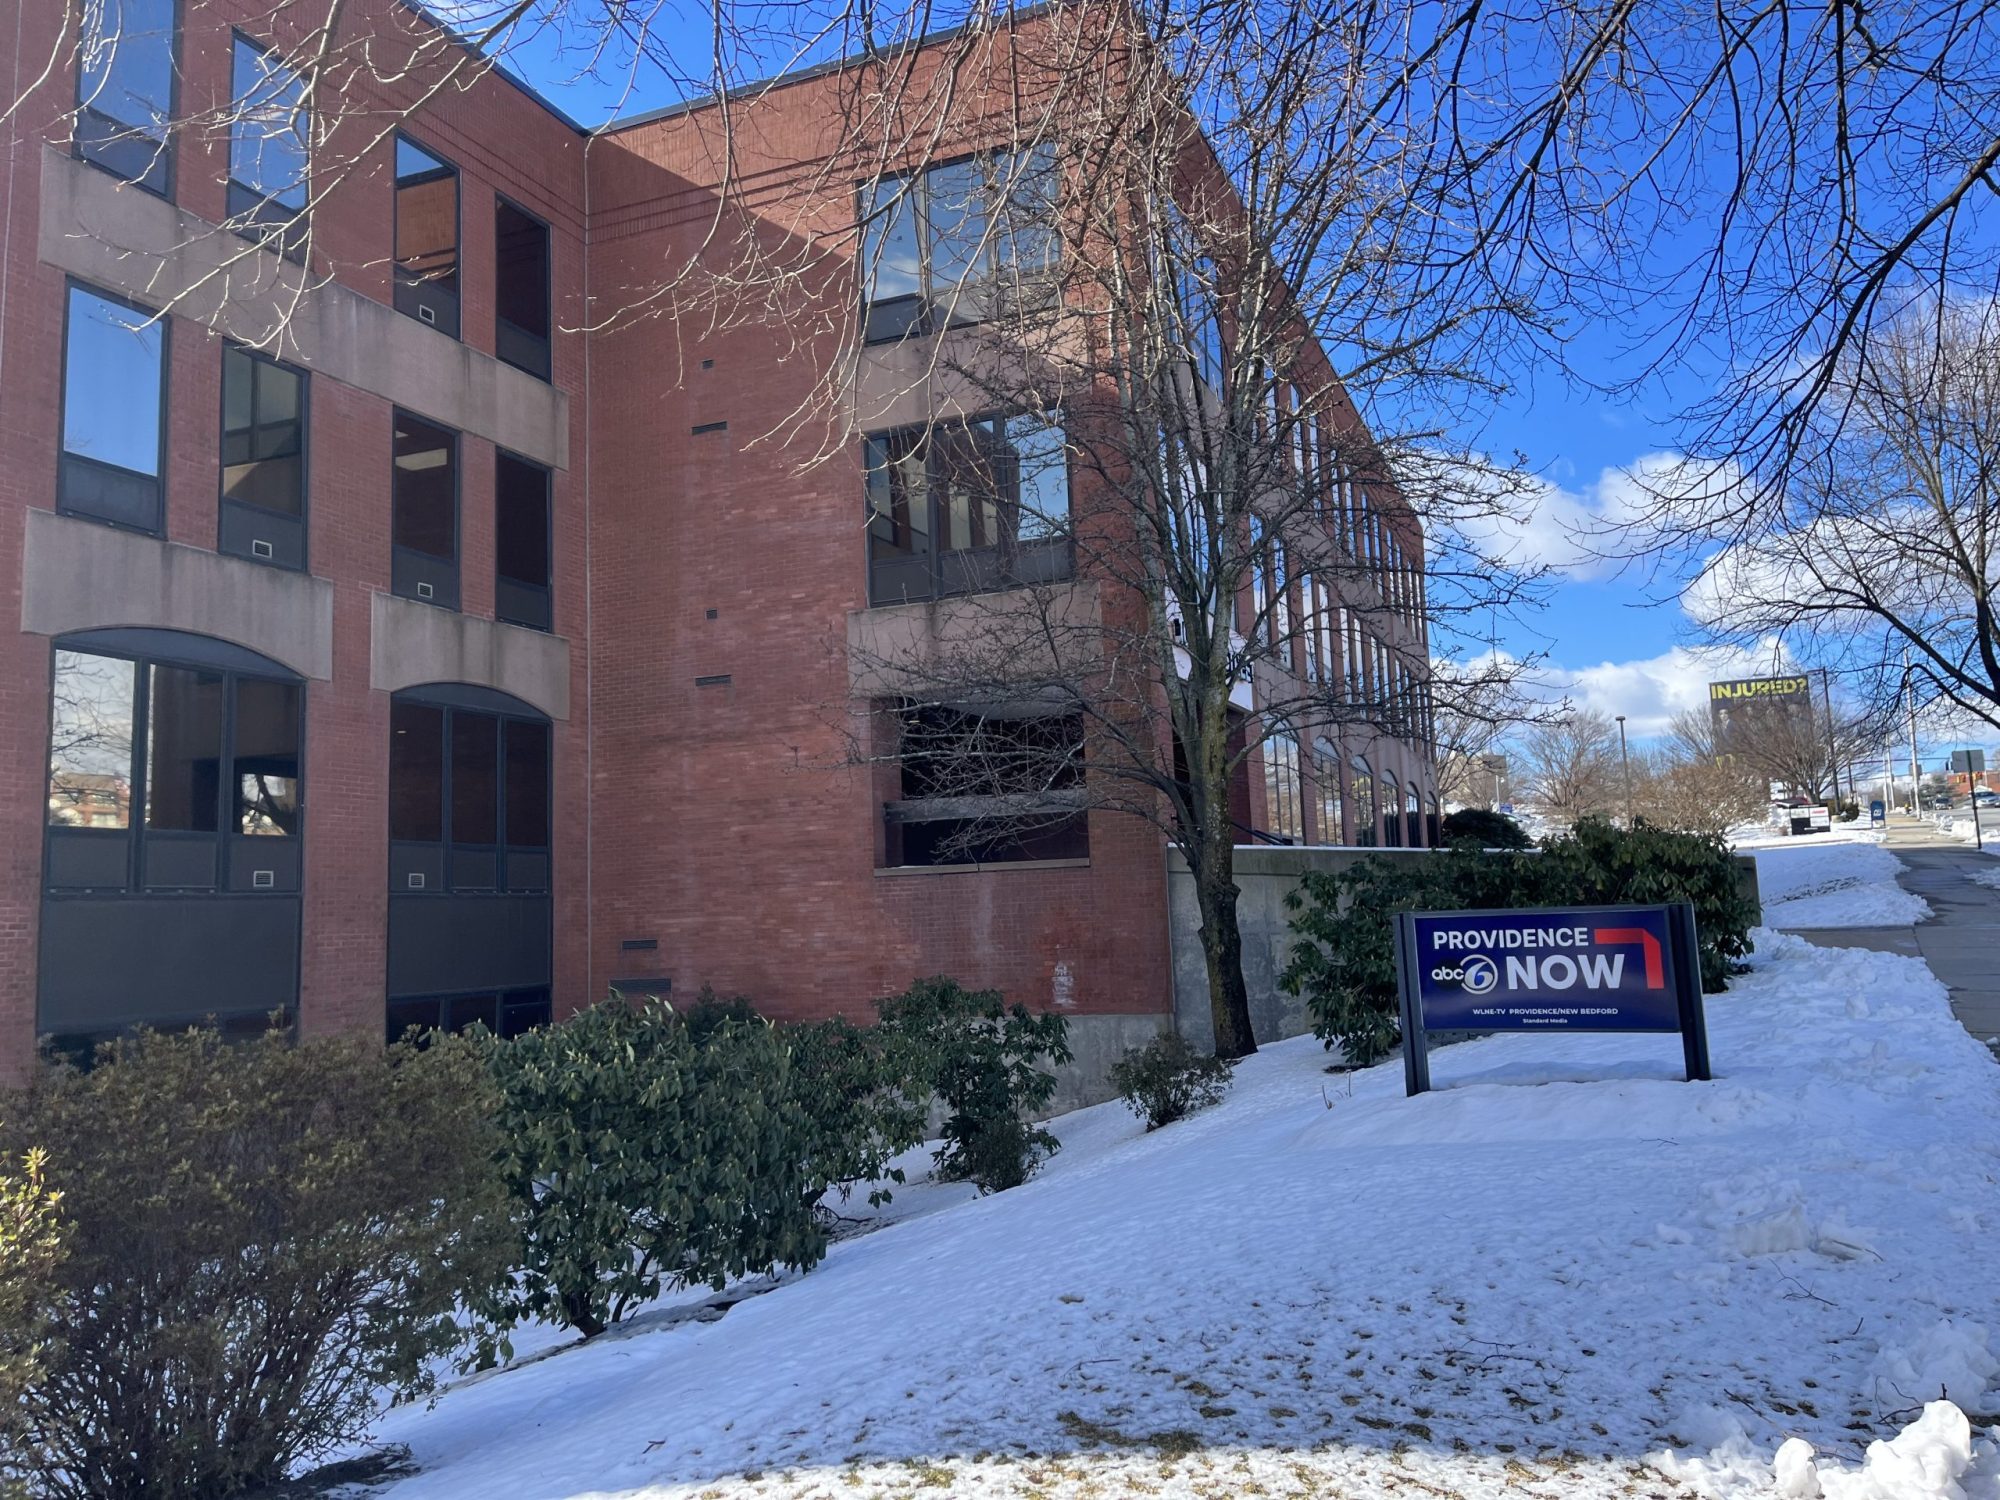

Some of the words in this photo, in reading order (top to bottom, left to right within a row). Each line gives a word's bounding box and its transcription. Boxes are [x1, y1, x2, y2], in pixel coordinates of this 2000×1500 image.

[1711, 678, 1808, 699] INJURED?
[1433, 927, 1589, 950] PROVIDENCE
[1431, 966, 1465, 981] abc
[1464, 961, 1494, 989] 6
[1506, 953, 1625, 990] NOW
[1509, 1008, 1579, 1016] PROVIDENCE/NEW
